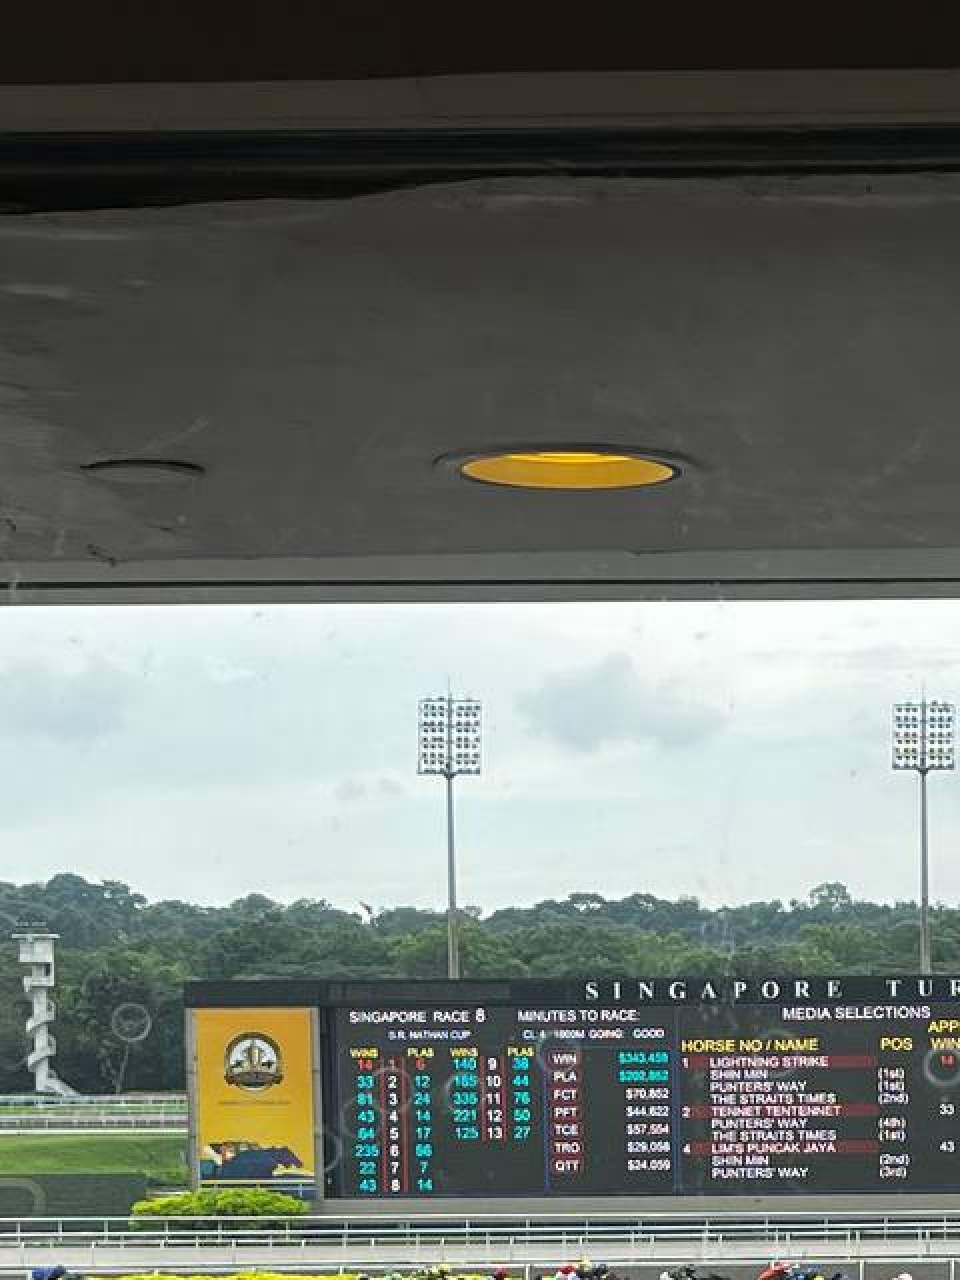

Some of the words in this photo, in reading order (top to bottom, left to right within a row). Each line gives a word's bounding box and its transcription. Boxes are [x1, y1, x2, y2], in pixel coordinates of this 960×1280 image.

[585, 980, 842, 999] SINGAPORE
[350, 1010, 427, 1023] SINGAPORE
[434, 1010, 471, 1023] RACE
[517, 1009, 577, 1022] MINUTES
[578, 1009, 599, 1021] TO
[783, 1007, 832, 1020] MEDIA
[835, 1006, 931, 1019] SELECTIONS
[450, 1030, 472, 1040] CUP
[633, 1029, 665, 1039] GOOD
[681, 1039, 735, 1052] HORSE
[739, 1039, 763, 1052] NO
[774, 1038, 820, 1051] NAME
[881, 1038, 913, 1051] POS
[931, 1037, 960, 1050] WIN
[552, 1053, 577, 1064] WIN
[710, 1056, 779, 1068] LIGHTNING
[782, 1056, 829, 1067] STRIKE
[553, 1071, 577, 1082] PLA
[710, 1069, 741, 1080] SHIN
[743, 1069, 768, 1079] MIN
[388, 1075, 397, 1088] 2
[486, 1075, 501, 1087] 10
[776, 1081, 807, 1091] WAY
[389, 1092, 398, 1105] 3
[486, 1092, 501, 1105] 11
[553, 1089, 577, 1100] FCT
[711, 1094, 737, 1104] THE
[739, 1094, 793, 1104] STRAITS
[799, 1093, 837, 1104] TIMES
[389, 1110, 398, 1122] 4
[487, 1110, 502, 1122] 12
[712, 1106, 762, 1116] TENNET
[778, 1118, 808, 1128] WAY
[390, 1127, 399, 1140] 5
[487, 1127, 502, 1139] 13
[712, 1130, 737, 1140] THE
[739, 1130, 795, 1140] STRAITS
[799, 1130, 837, 1140] TIMES
[555, 1141, 581, 1153] TRO
[747, 1143, 801, 1153] PUNCAK
[803, 1143, 837, 1153] JAYA
[555, 1160, 579, 1171] QTT
[712, 1155, 743, 1165] SHIN
[745, 1155, 769, 1165] MIN
[390, 1162, 399, 1174] 7
[778, 1168, 809, 1178] WAY
